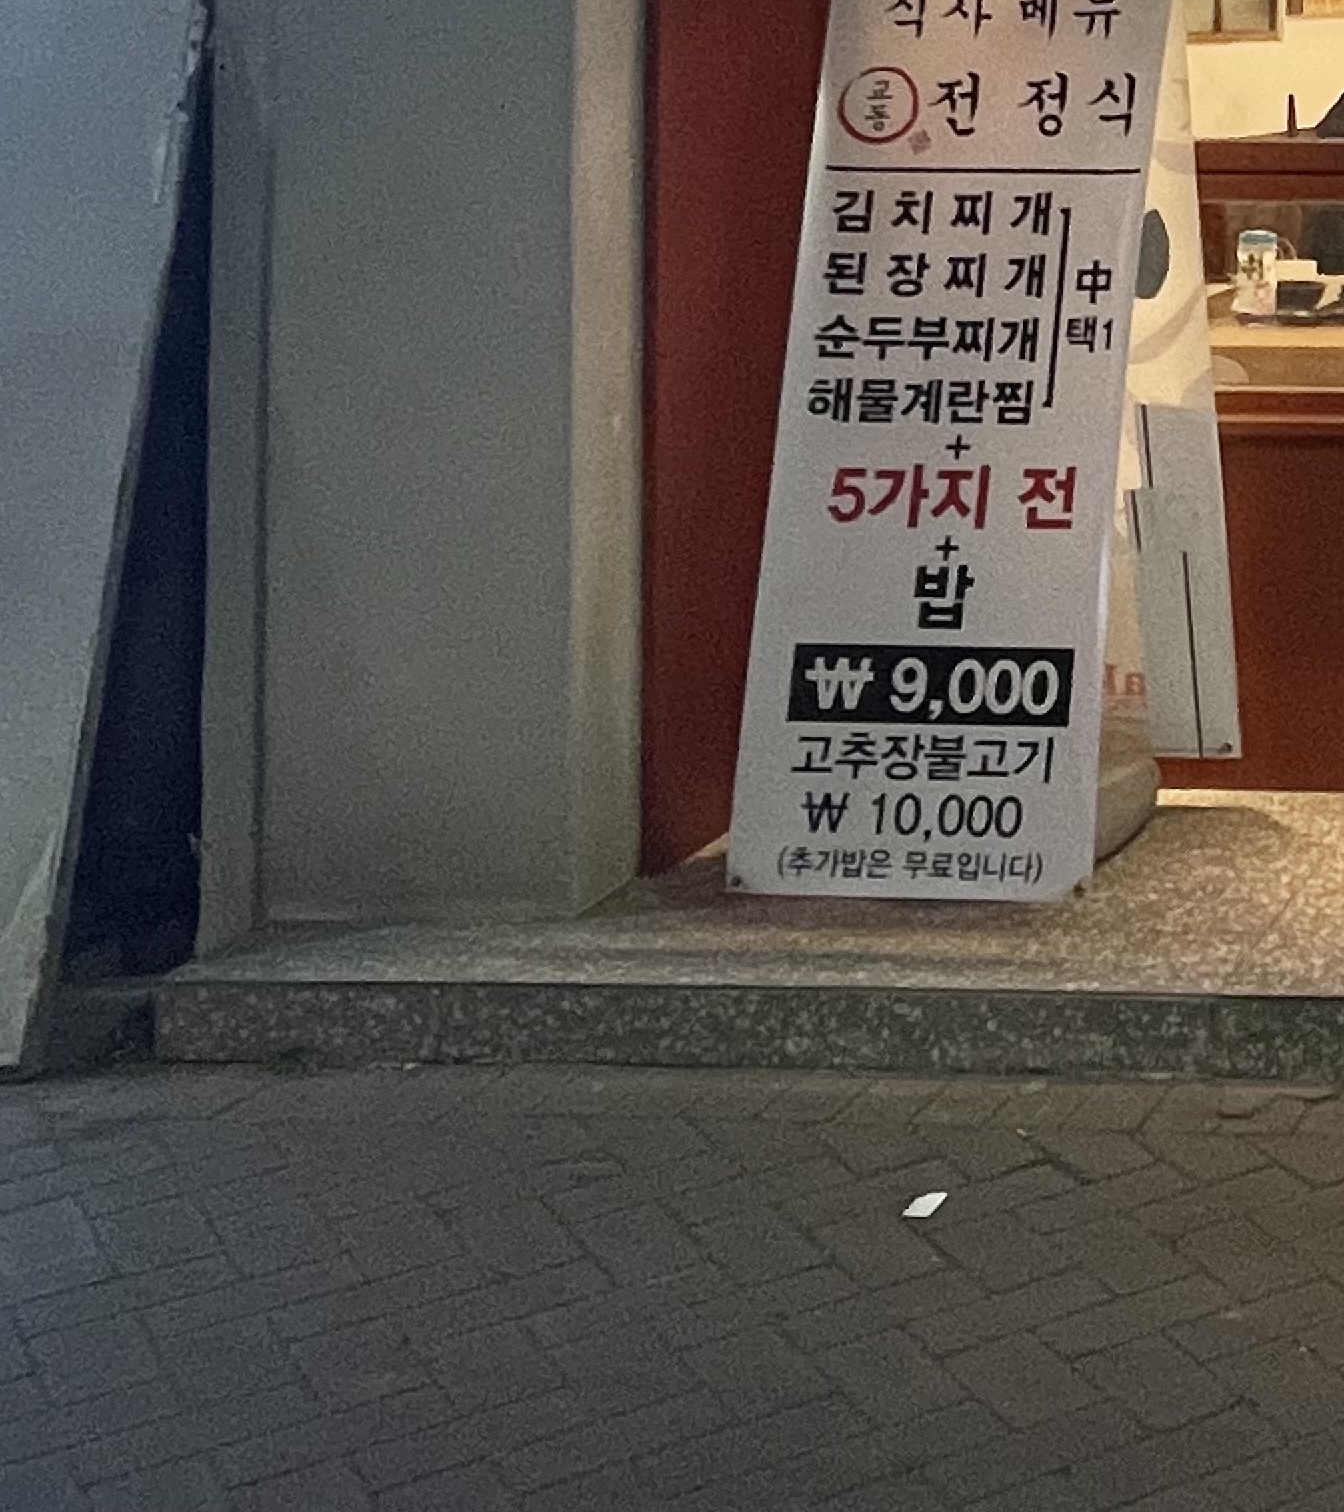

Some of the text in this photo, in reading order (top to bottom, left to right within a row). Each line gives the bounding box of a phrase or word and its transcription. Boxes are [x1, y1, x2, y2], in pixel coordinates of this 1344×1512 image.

[865, 72, 1135, 137] 교동 전 정식
[833, 190, 1052, 235] 김치찌개
[823, 252, 1045, 298] 된장찌개
[1076, 260, 1111, 304] 中
[815, 315, 1039, 362] 순두부찌개
[1067, 317, 1113, 353] 택1
[808, 378, 1033, 425] 해물계란찜
[827, 464, 1076, 529] 5가지 전
[914, 565, 975, 629] 밥
[891, 657, 1059, 719] 9,000
[791, 733, 1053, 783] 고추장불고기
[872, 793, 1022, 842] 10,000
[777, 846, 1043, 883] (추가밥은 무료입니다)
